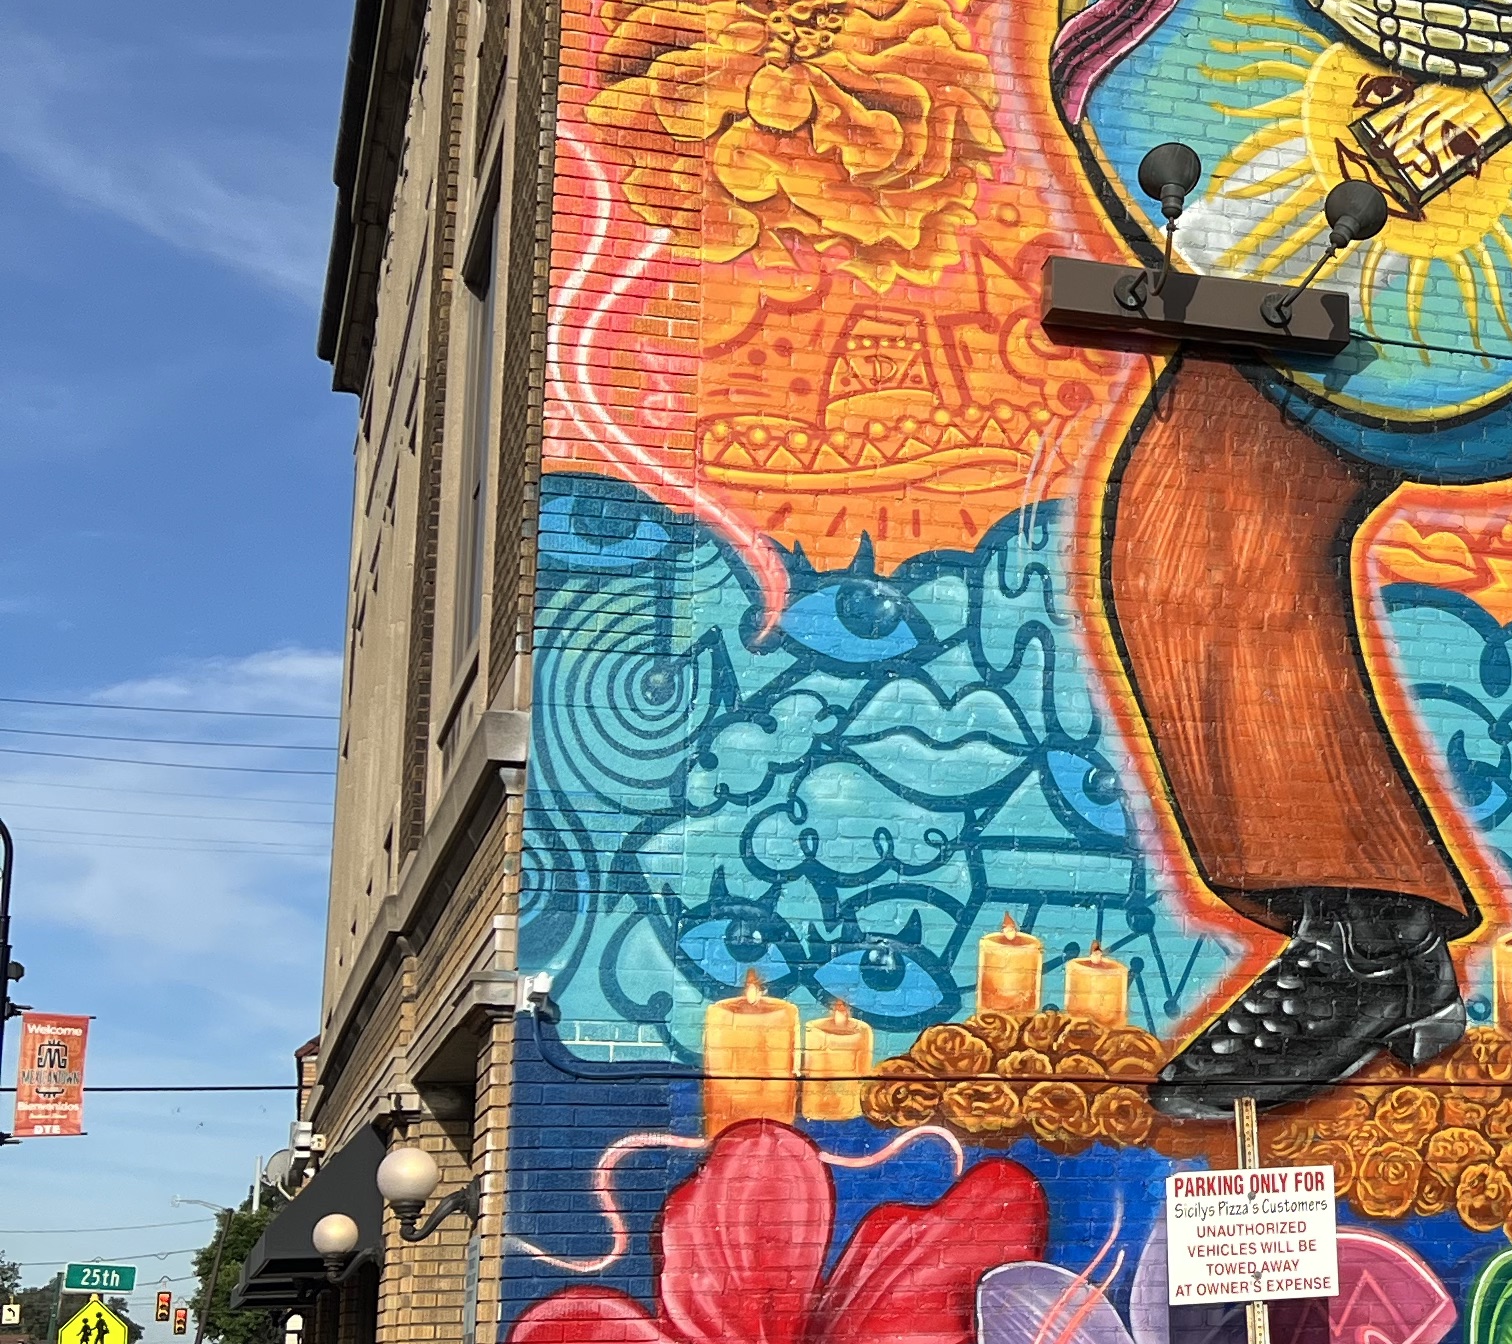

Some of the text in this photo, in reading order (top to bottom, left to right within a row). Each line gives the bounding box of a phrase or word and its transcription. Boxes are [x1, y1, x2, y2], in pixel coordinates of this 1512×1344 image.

[27, 1023, 83, 1036] Welcome
[33, 1124, 61, 1134] DTE
[1174, 1171, 1325, 1198] PARKING ONLY FOR
[1174, 1201, 1215, 1221] Sicilys
[1262, 1198, 1328, 1214] Customers
[1197, 1221, 1307, 1238] UNAUTHORIZED
[1187, 1239, 1317, 1258] VEHICLES WILL BE
[1206, 1259, 1300, 1276] TOWED AWAY
[80, 1268, 120, 1287] 25th
[1175, 1276, 1332, 1297] AT OWNER'S EXPENSE
